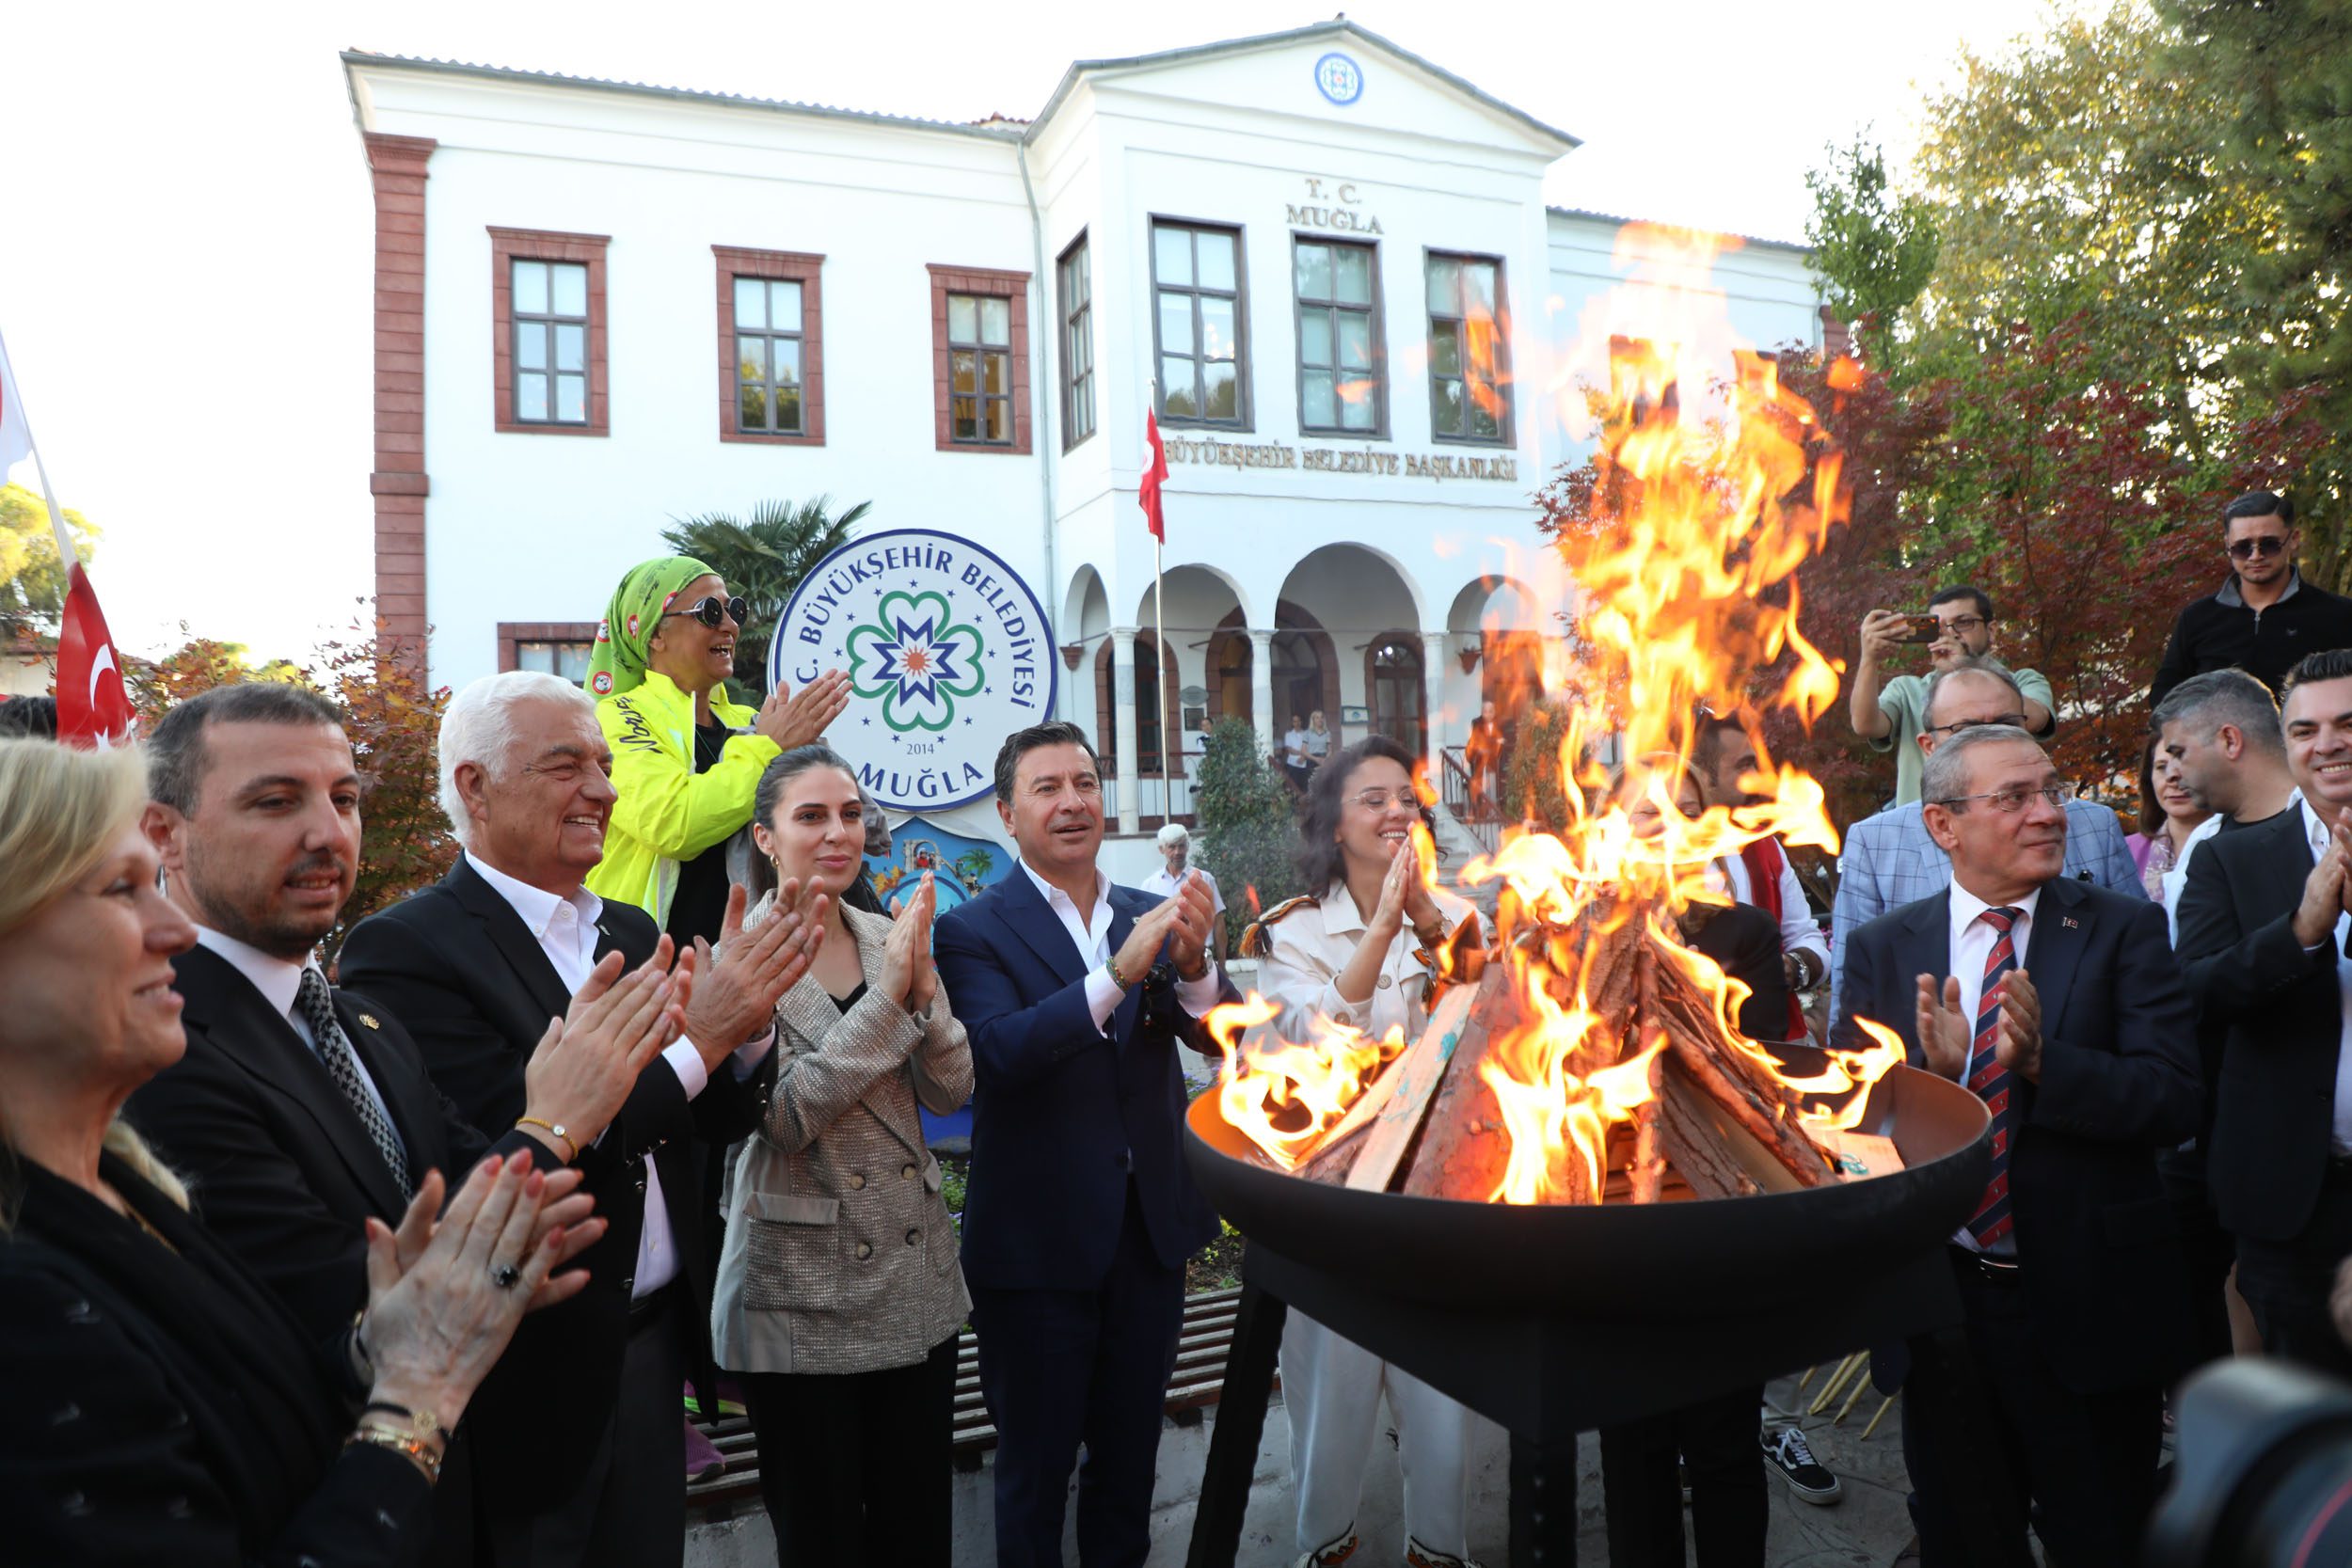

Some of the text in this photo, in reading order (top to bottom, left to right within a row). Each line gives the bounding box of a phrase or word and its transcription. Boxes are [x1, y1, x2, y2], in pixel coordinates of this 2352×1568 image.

[1285, 203, 1384, 234] MUĞLA
[1164, 435, 1518, 483] BÜYÜKŞEHİR BELEDİYE BAŞKANLIĞI
[800, 543, 953, 645] BÜYÜKŞEHİR
[961, 562, 1035, 709] BELEDİYESİ
[906, 743, 935, 755] 2014
[857, 761, 984, 799] MUĞLA
